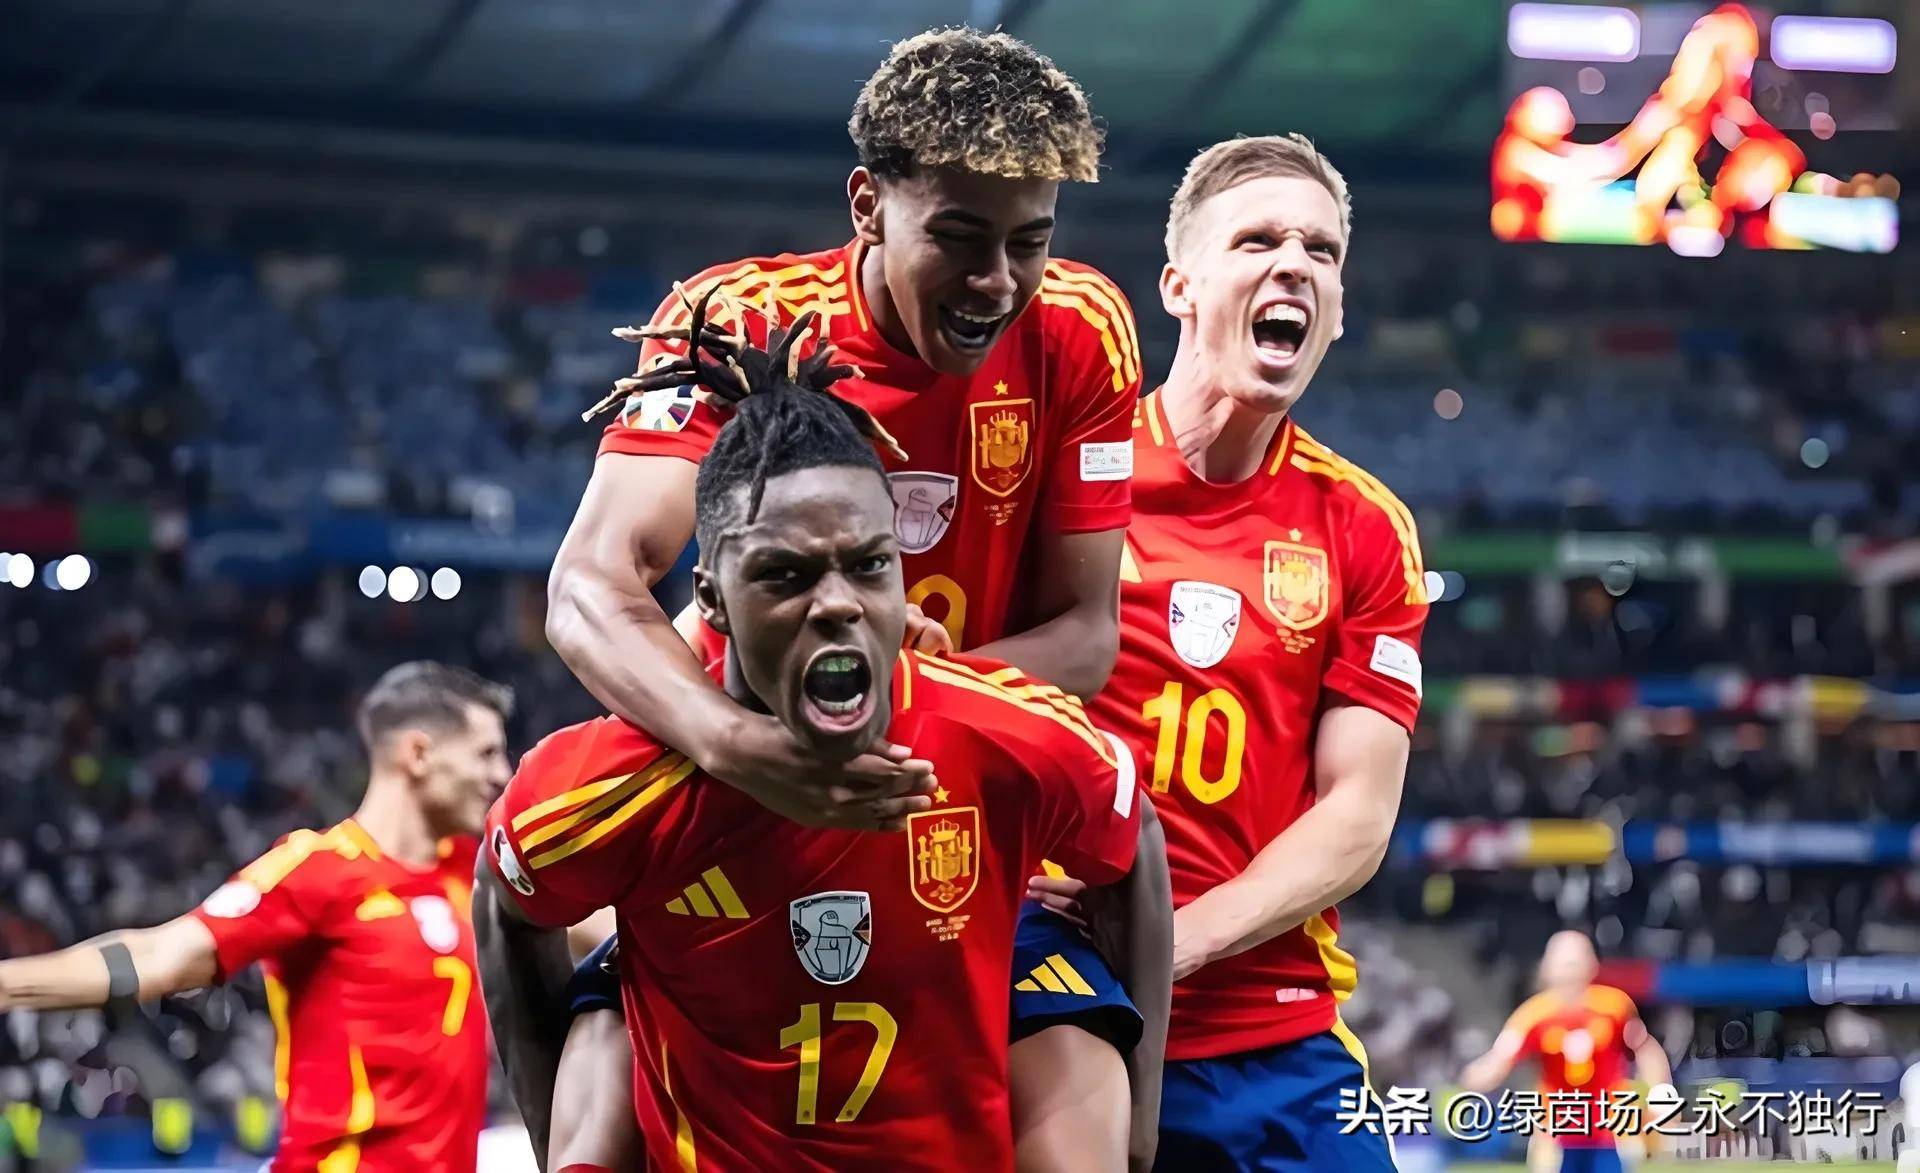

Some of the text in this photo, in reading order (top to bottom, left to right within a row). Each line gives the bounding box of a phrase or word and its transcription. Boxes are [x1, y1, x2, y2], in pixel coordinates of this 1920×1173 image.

[1142, 681, 1246, 804] 10
[432, 955, 472, 1035] 7
[780, 1002, 898, 1124] 17
